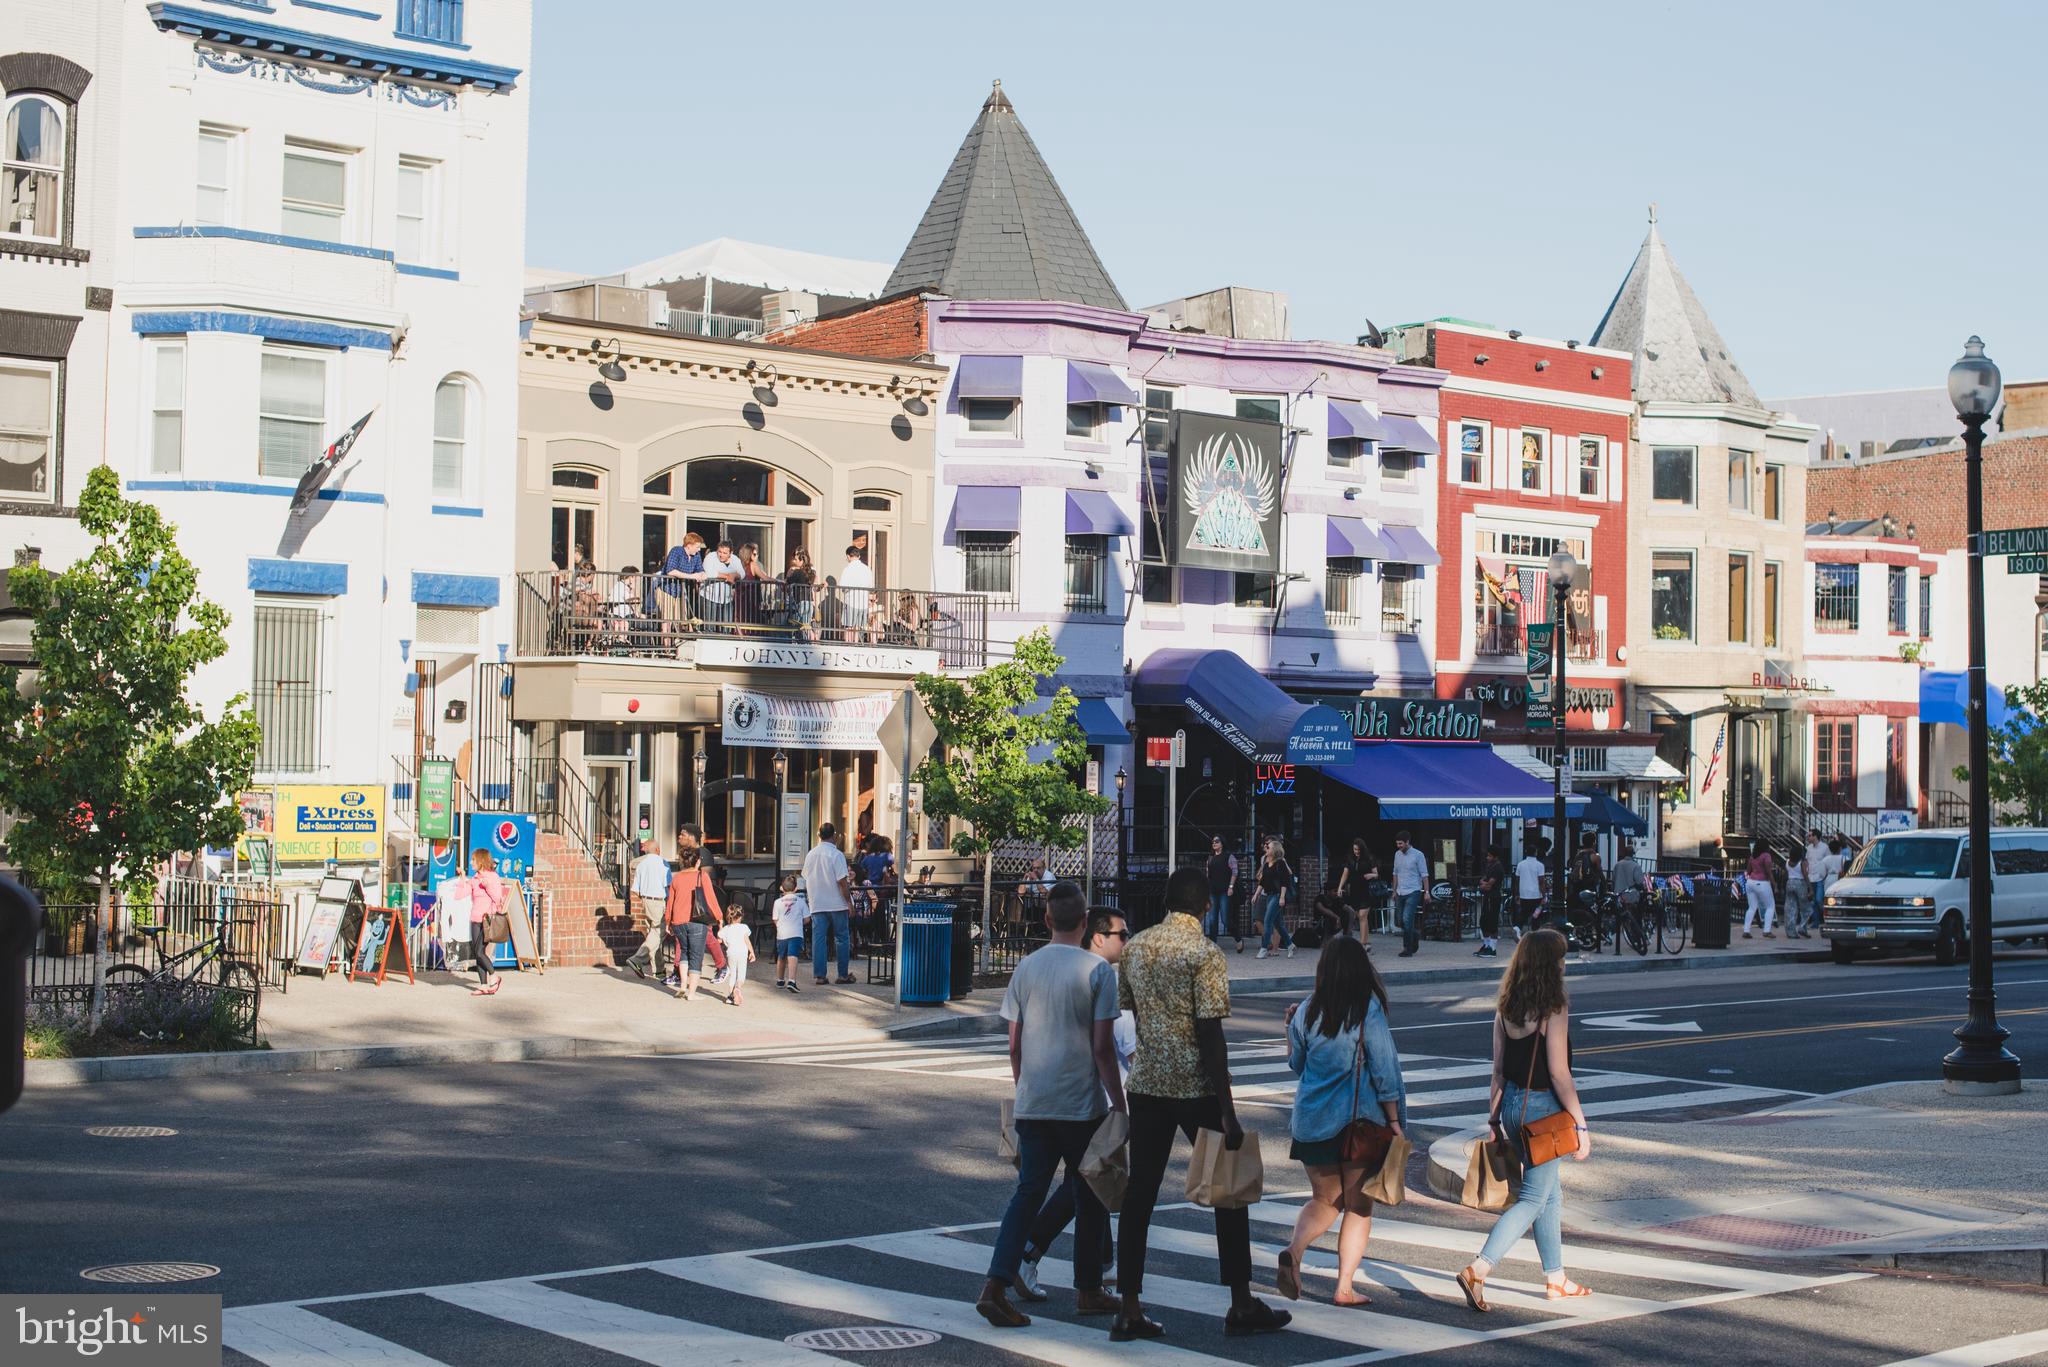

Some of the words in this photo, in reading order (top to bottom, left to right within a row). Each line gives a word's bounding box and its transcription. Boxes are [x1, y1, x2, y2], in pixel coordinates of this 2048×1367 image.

[2009, 558, 2045, 572] 1800
[730, 647, 812, 665] JOHNNY
[821, 652, 913, 669] PISTOLAS
[1528, 631, 1551, 700] LIVE
[1477, 683, 1495, 702] The
[1185, 697, 1203, 714] GREEN
[1202, 710, 1222, 729] ISLAND
[1528, 704, 1549, 712] ADAMS
[1400, 701, 1481, 739] Station
[1220, 723, 1255, 755] Heaven
[1261, 753, 1283, 763] HELL
[1289, 736, 1323, 751] Heaven
[1331, 741, 1353, 750] HELL
[1256, 764, 1296, 780] LIVE
[1256, 780, 1296, 795] JAZZ
[344, 792, 361, 801] ATM
[1450, 805, 1488, 817] Columbia
[1492, 805, 1522, 817] Station
[340, 822, 354, 831] Cold
[355, 822, 374, 831] Drinks
